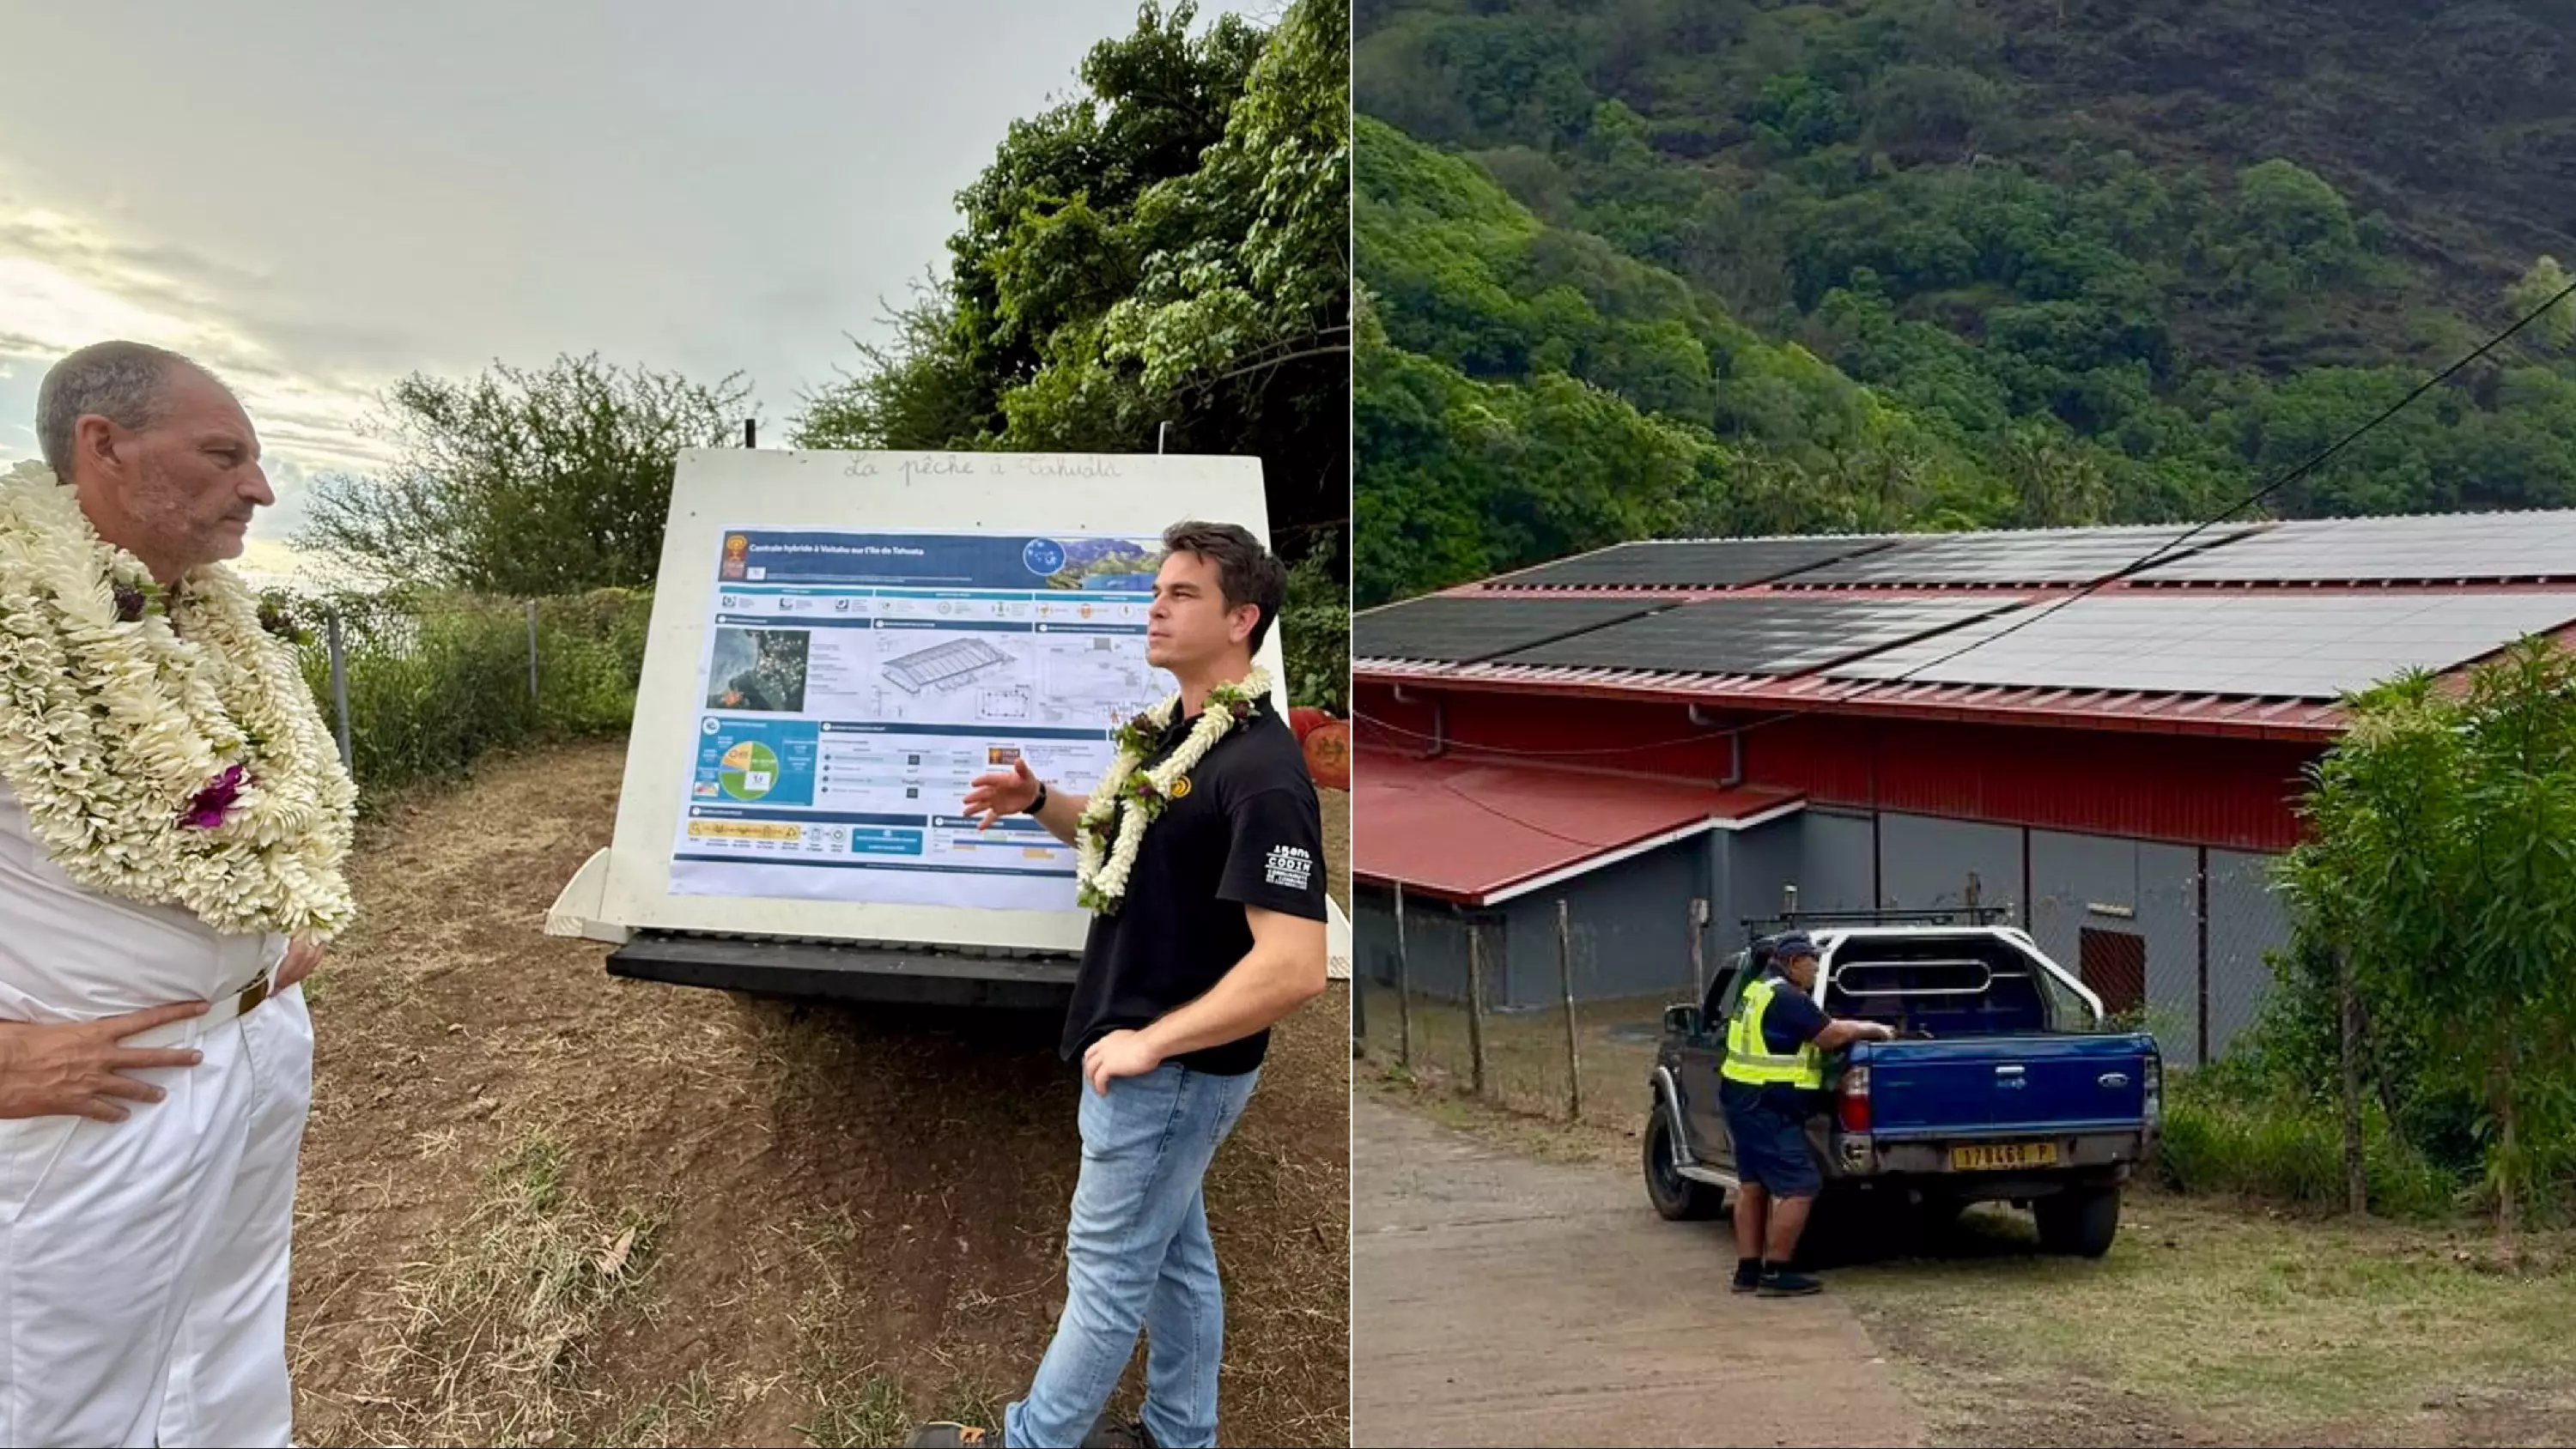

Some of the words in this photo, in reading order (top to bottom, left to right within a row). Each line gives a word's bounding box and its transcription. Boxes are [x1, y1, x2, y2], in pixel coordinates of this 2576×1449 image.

[842, 452, 879, 477] La
[898, 455, 974, 486] pêche
[783, 543, 813, 555] hybride
